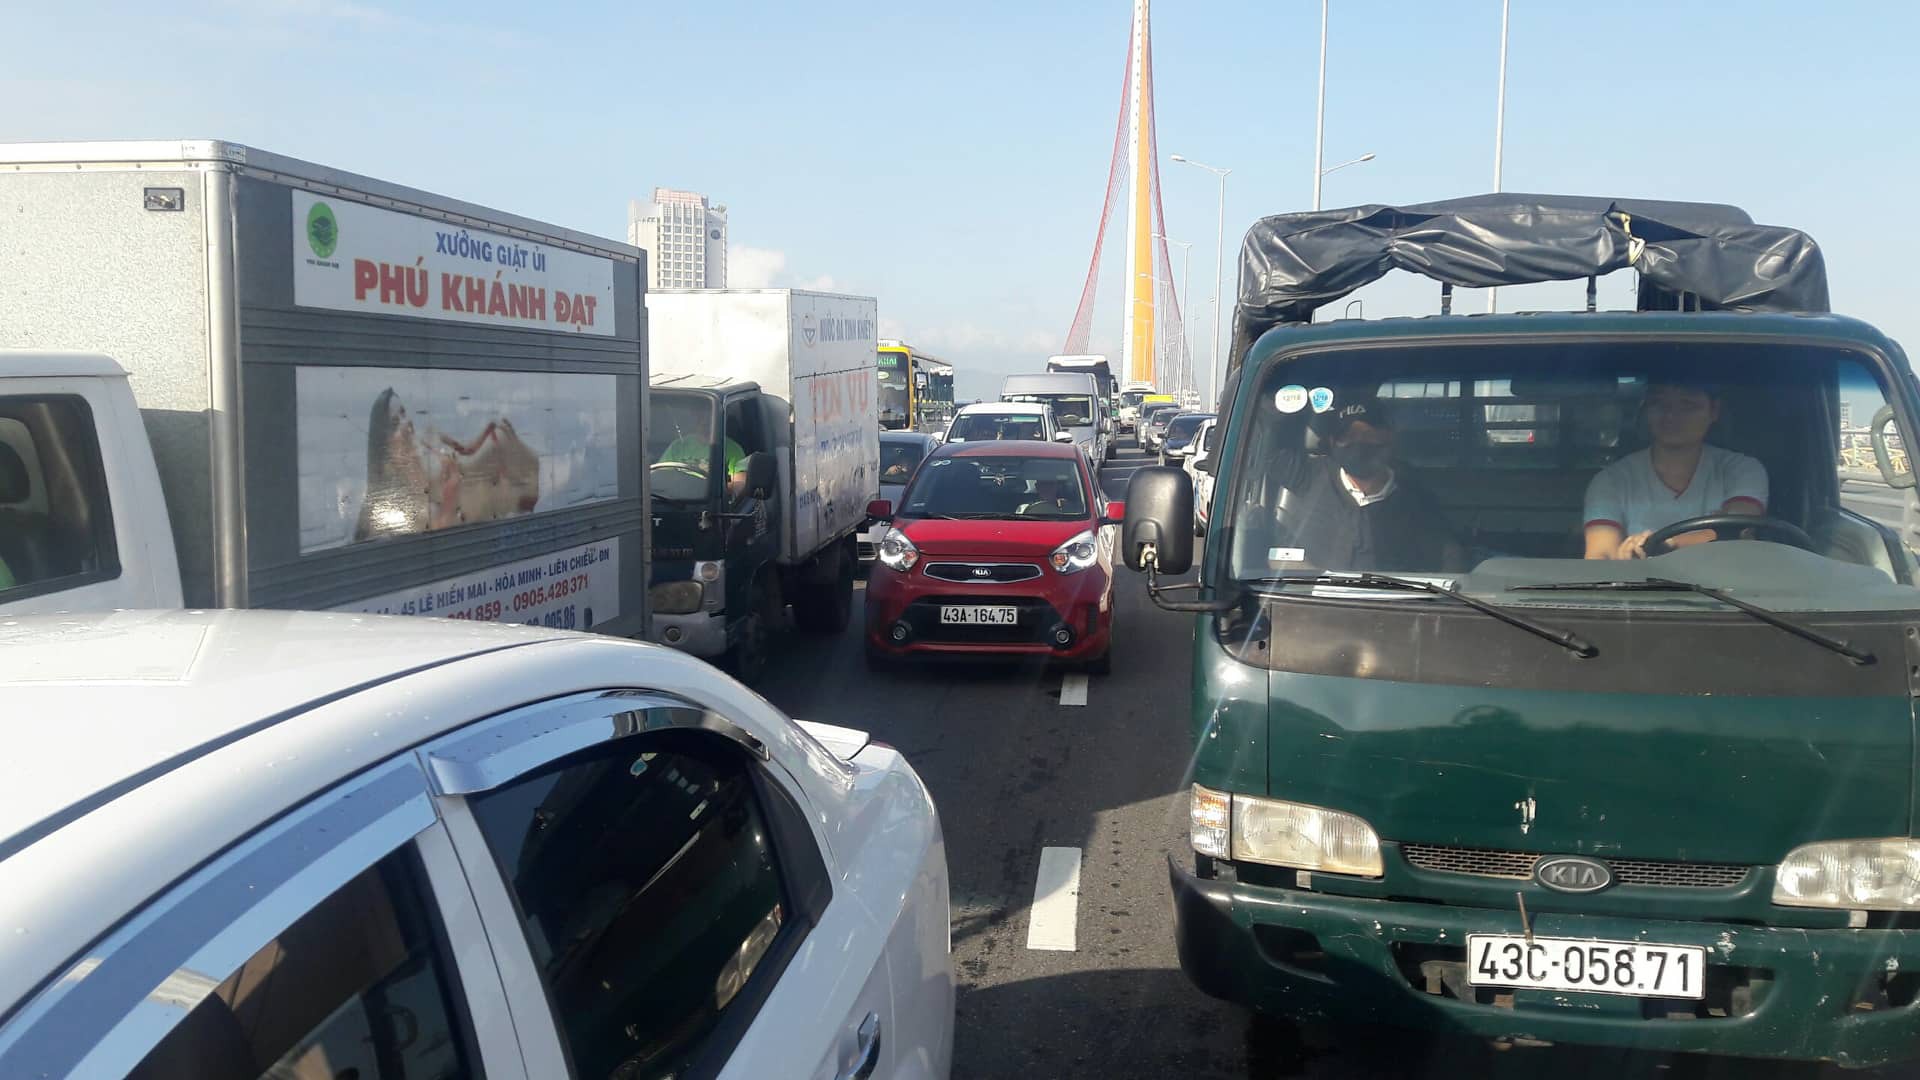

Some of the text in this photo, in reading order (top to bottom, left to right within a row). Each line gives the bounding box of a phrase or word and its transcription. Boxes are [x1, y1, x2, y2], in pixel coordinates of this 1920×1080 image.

[436, 229, 546, 272] XƯỞNG GIẶT ỦI
[354, 257, 598, 332] PHÚ KHÁNH ĐẠT
[467, 581, 487, 600] MAI
[518, 566, 542, 587] MINH
[549, 558, 568, 577] LIÊN
[943, 607, 1015, 623] 43A-164.75
[1550, 865, 1599, 886] KIA
[1478, 941, 1690, 993] 43C-058.71
